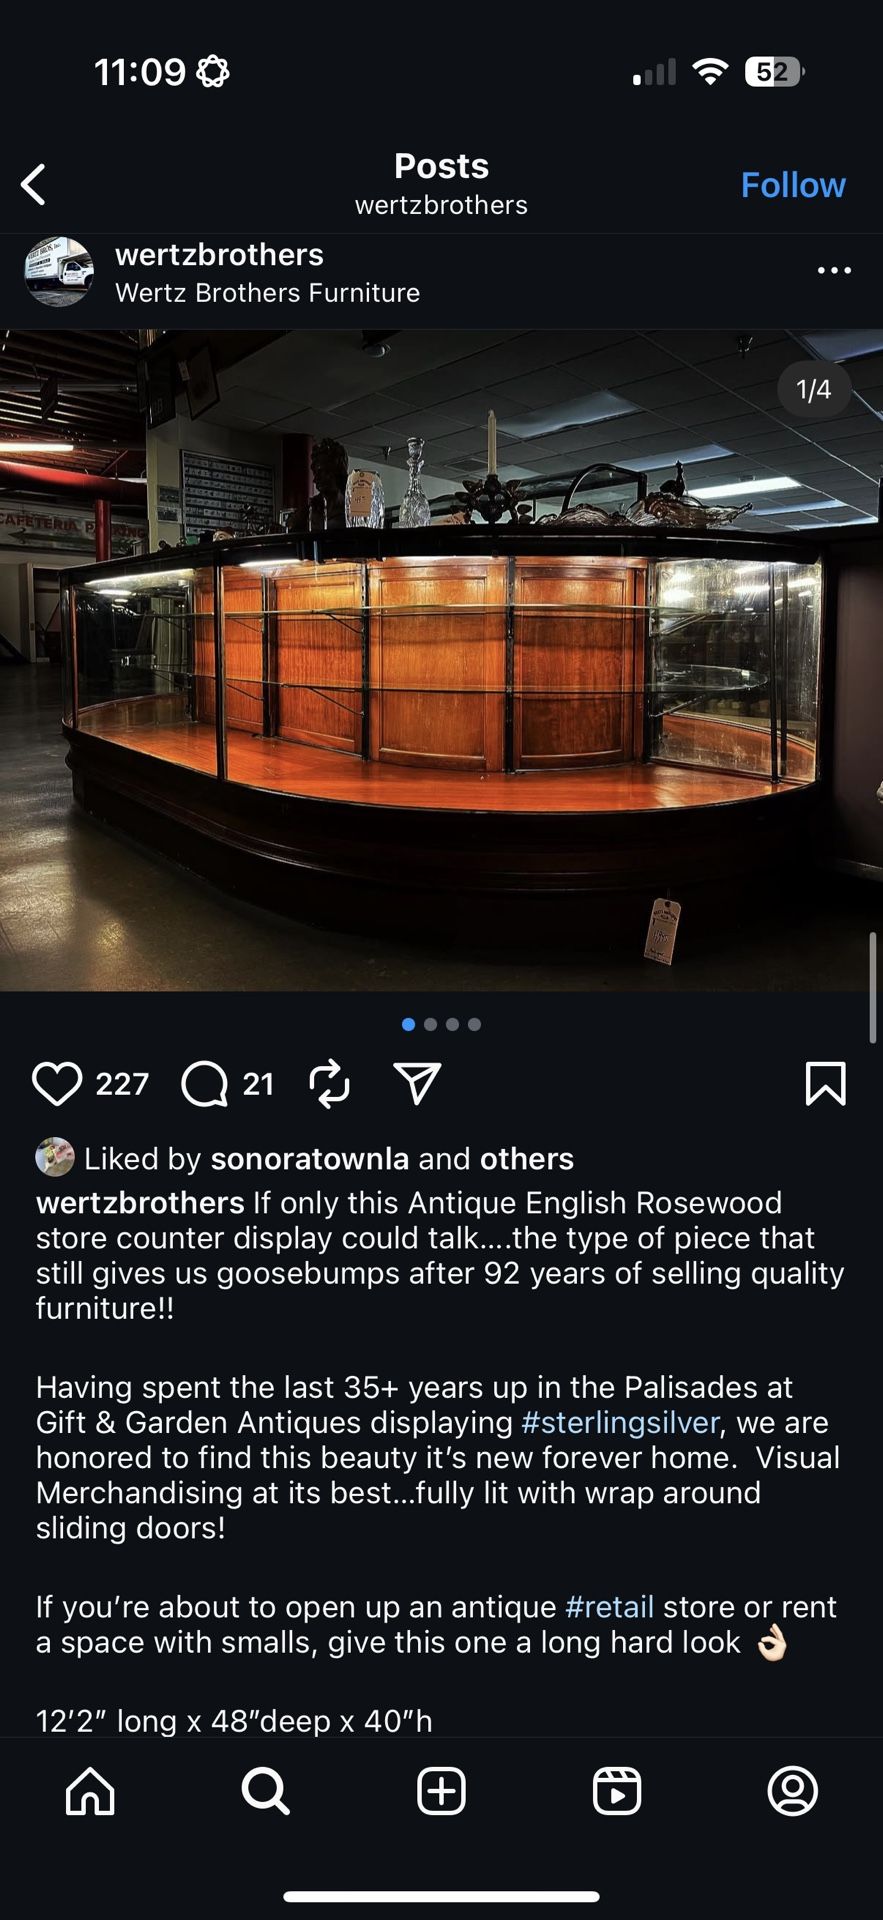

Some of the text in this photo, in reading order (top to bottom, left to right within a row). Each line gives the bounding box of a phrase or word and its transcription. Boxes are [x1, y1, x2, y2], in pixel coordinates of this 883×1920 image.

[95, 58, 185, 86] 11:09
[757, 62, 788, 82] 52
[396, 153, 489, 179] Posts
[743, 171, 846, 198] Follow
[355, 194, 527, 214] wertzbrothers
[115, 242, 323, 266] wertzbrothers
[116, 282, 420, 302] Wertz Brothers Furniture
[797, 379, 831, 404] 1/4
[85, 521, 145, 538] PKING
[96, 1072, 149, 1095] 227
[244, 1072, 272, 1095] 21
[86, 1146, 573, 1175] Liked by sonoratownla and others
[36, 1190, 781, 1219] wertzbrothers If only this Antique English Rosewood
[37, 1228, 106, 1249] store
[117, 1228, 224, 1249] counter
[234, 1226, 332, 1254] display
[343, 1226, 417, 1249] could
[566, 1228, 628, 1254] type
[638, 1226, 665, 1249] of
[676, 1226, 750, 1254] piece
[760, 1226, 815, 1249] that
[37, 1261, 844, 1290] still gives us goosebumps after 92 years of selling quality
[36, 1296, 172, 1319] furniture!!
[38, 1375, 792, 1404] Having spent the last 35+ years up in the Palisades at
[37, 1410, 828, 1439] Gift & Garden Antiques displaying #sterlingsilver, we are
[37, 1445, 151, 1469] honored
[162, 1448, 188, 1469] to
[198, 1445, 250, 1469] find
[261, 1445, 310, 1469] this
[322, 1445, 417, 1474] beauty
[477, 1451, 533, 1469] new
[542, 1445, 642, 1469] forever
[652, 1445, 736, 1469] home.
[756, 1445, 839, 1469] Visual
[38, 1480, 241, 1509] Merchandising
[253, 1483, 278, 1504] at
[290, 1480, 320, 1504] its
[485, 1480, 508, 1504] lit
[518, 1480, 575, 1504] with
[585, 1486, 654, 1509] wrap
[664, 1480, 760, 1504] around
[37, 1515, 224, 1544] sliding doors!
[38, 1595, 53, 1618] If
[160, 1595, 239, 1618] about
[249, 1597, 275, 1618] to
[286, 1601, 354, 1623] open
[367, 1601, 400, 1623] up
[410, 1601, 442, 1618] an
[452, 1595, 556, 1623] antique
[566, 1595, 653, 1618] #retail
[664, 1597, 734, 1618] store
[745, 1601, 773, 1618] or
[783, 1597, 836, 1618] rent
[37, 1630, 741, 1659] a space with smalls, give this one a long hard look
[119, 1709, 176, 1737] long
[187, 1715, 201, 1732] x
[340, 1715, 354, 1732] x
